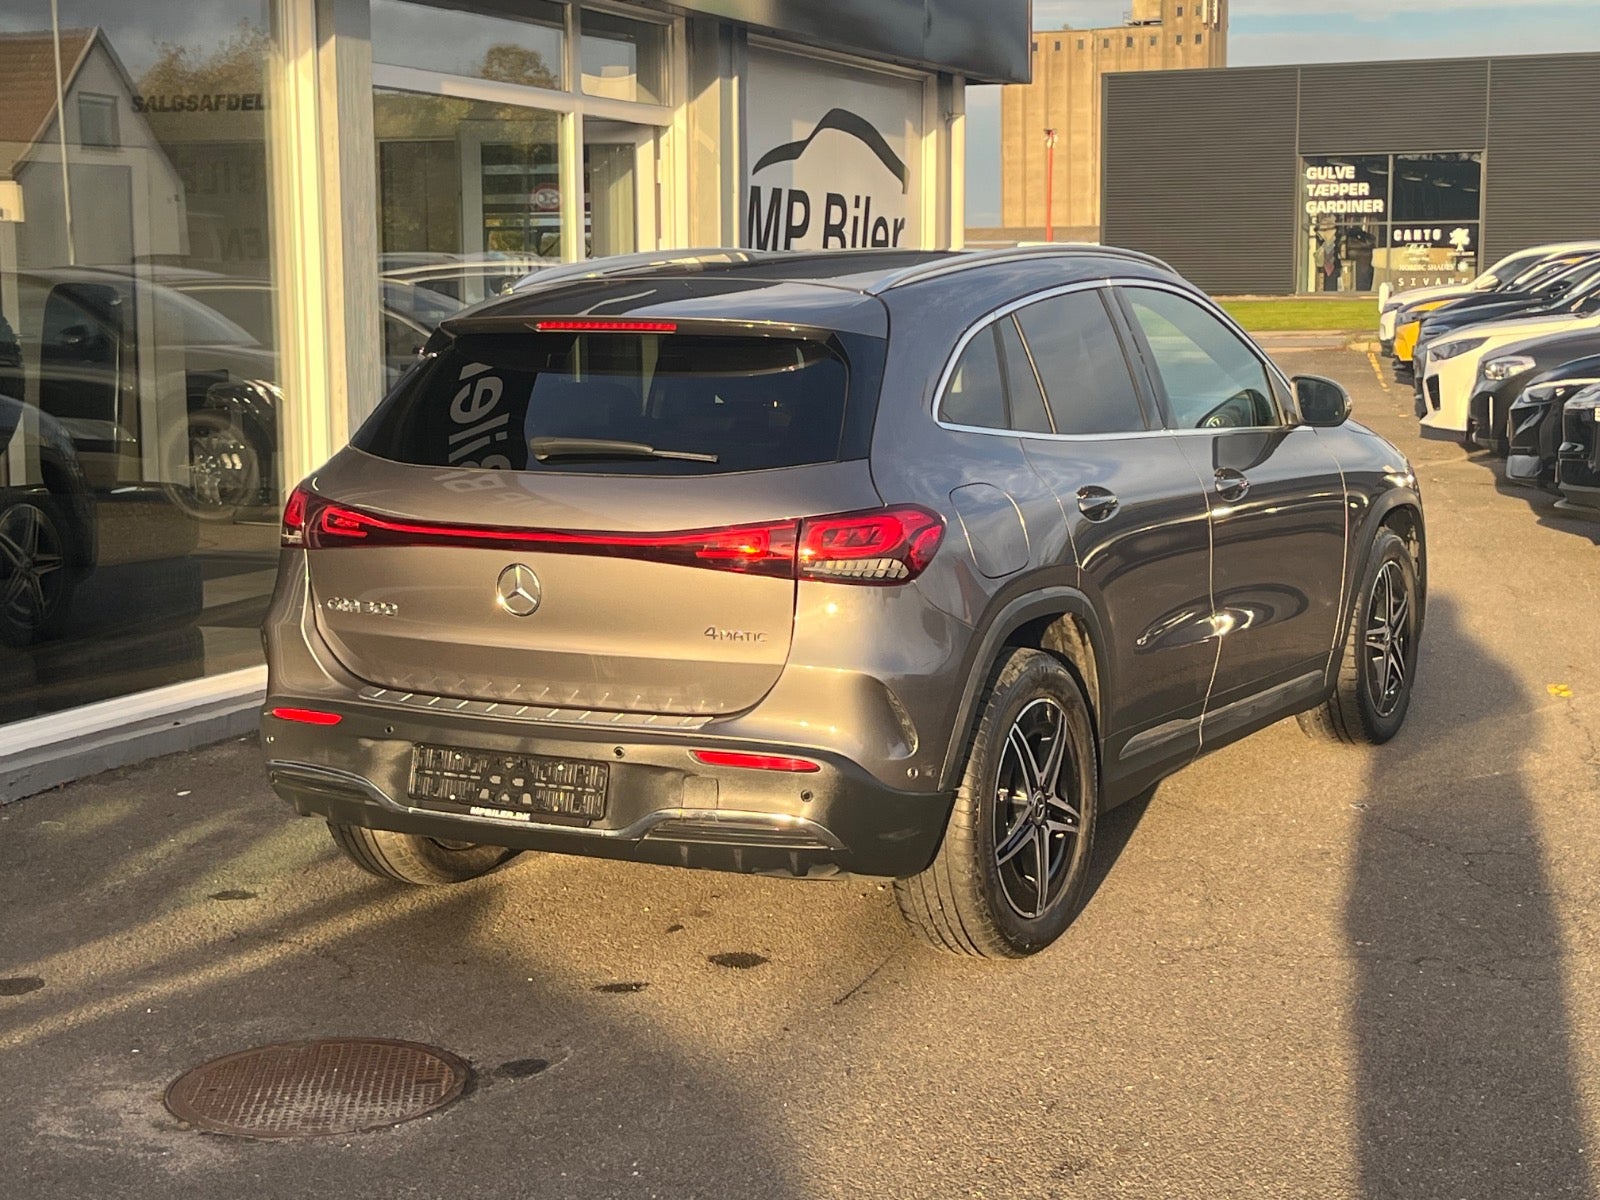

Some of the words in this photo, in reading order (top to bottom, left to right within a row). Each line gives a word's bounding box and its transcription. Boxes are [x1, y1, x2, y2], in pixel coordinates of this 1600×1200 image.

[1306, 165, 1356, 180] GULVE
[1306, 182, 1370, 197] TÆPPER
[1305, 199, 1385, 214] GARDINER
[749, 185, 811, 251] MP
[822, 192, 906, 250] Biler
[703, 626, 769, 643] 4MATIC
